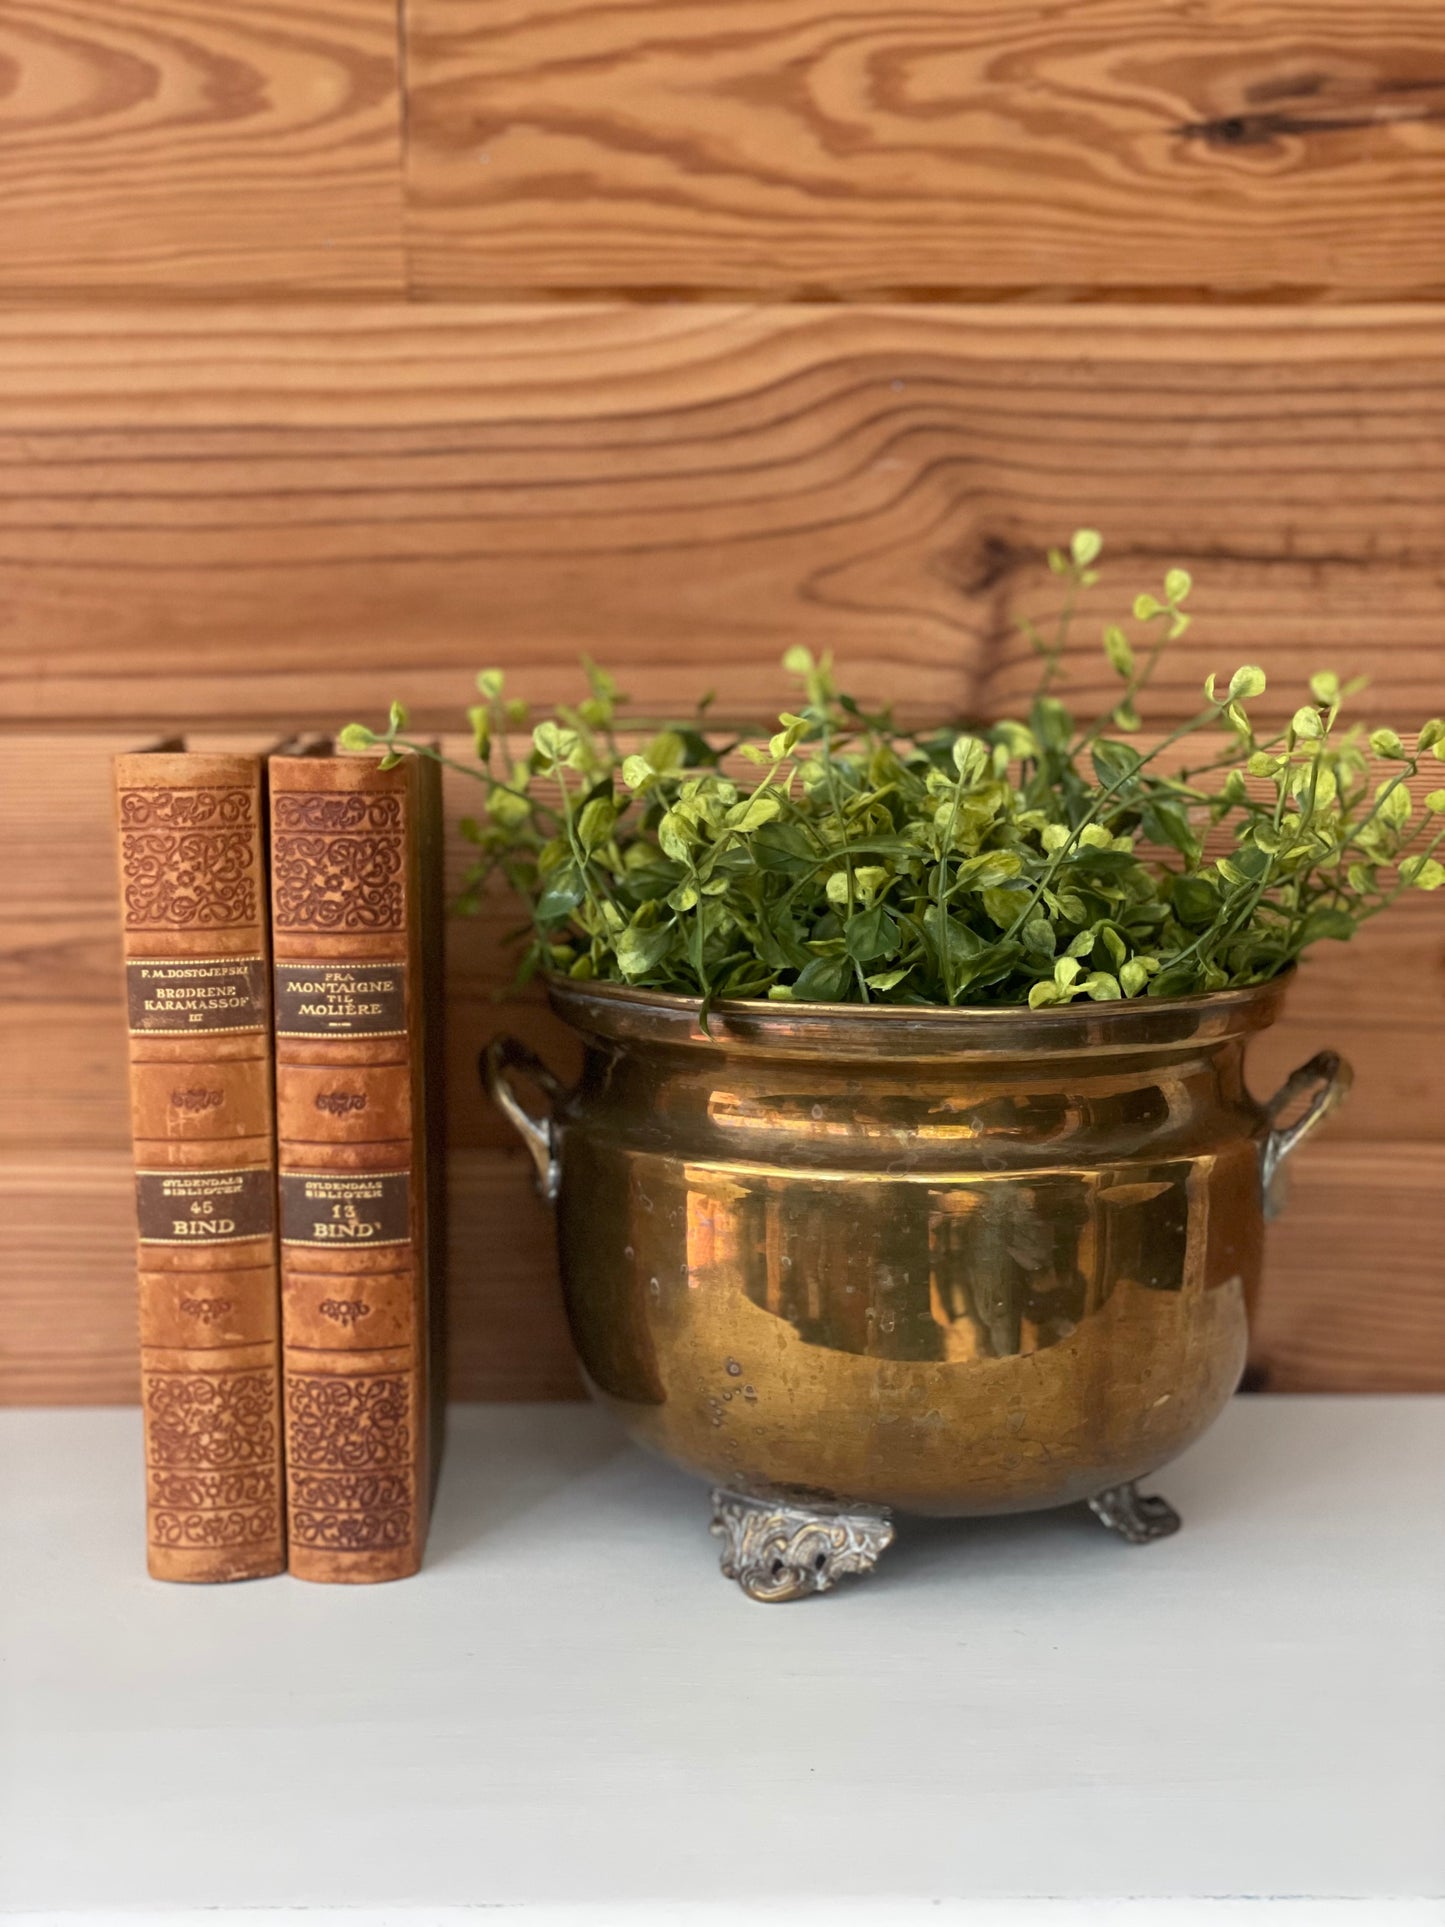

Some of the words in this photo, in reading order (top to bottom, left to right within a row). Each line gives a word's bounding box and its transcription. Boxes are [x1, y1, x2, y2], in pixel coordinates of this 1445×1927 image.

[325, 973, 355, 981] FRA
[156, 986, 236, 998] BRØDRENE
[286, 981, 394, 993] MONTAIGNE
[144, 997, 249, 1010] KARAMASSOF
[326, 995, 354, 1003] TIL
[298, 1003, 382, 1016] MOLIÈRE
[162, 1177, 243, 1187] GYLDENDALS
[305, 1181, 383, 1190] GYLDENDALS
[163, 1186, 243, 1196] BIBLIOTEK
[305, 1190, 383, 1199] BIBLIOTEK
[190, 1201, 214, 1214] 45
[332, 1204, 356, 1218] 13
[172, 1219, 235, 1235] BIND
[313, 1223, 374, 1238] BIND
